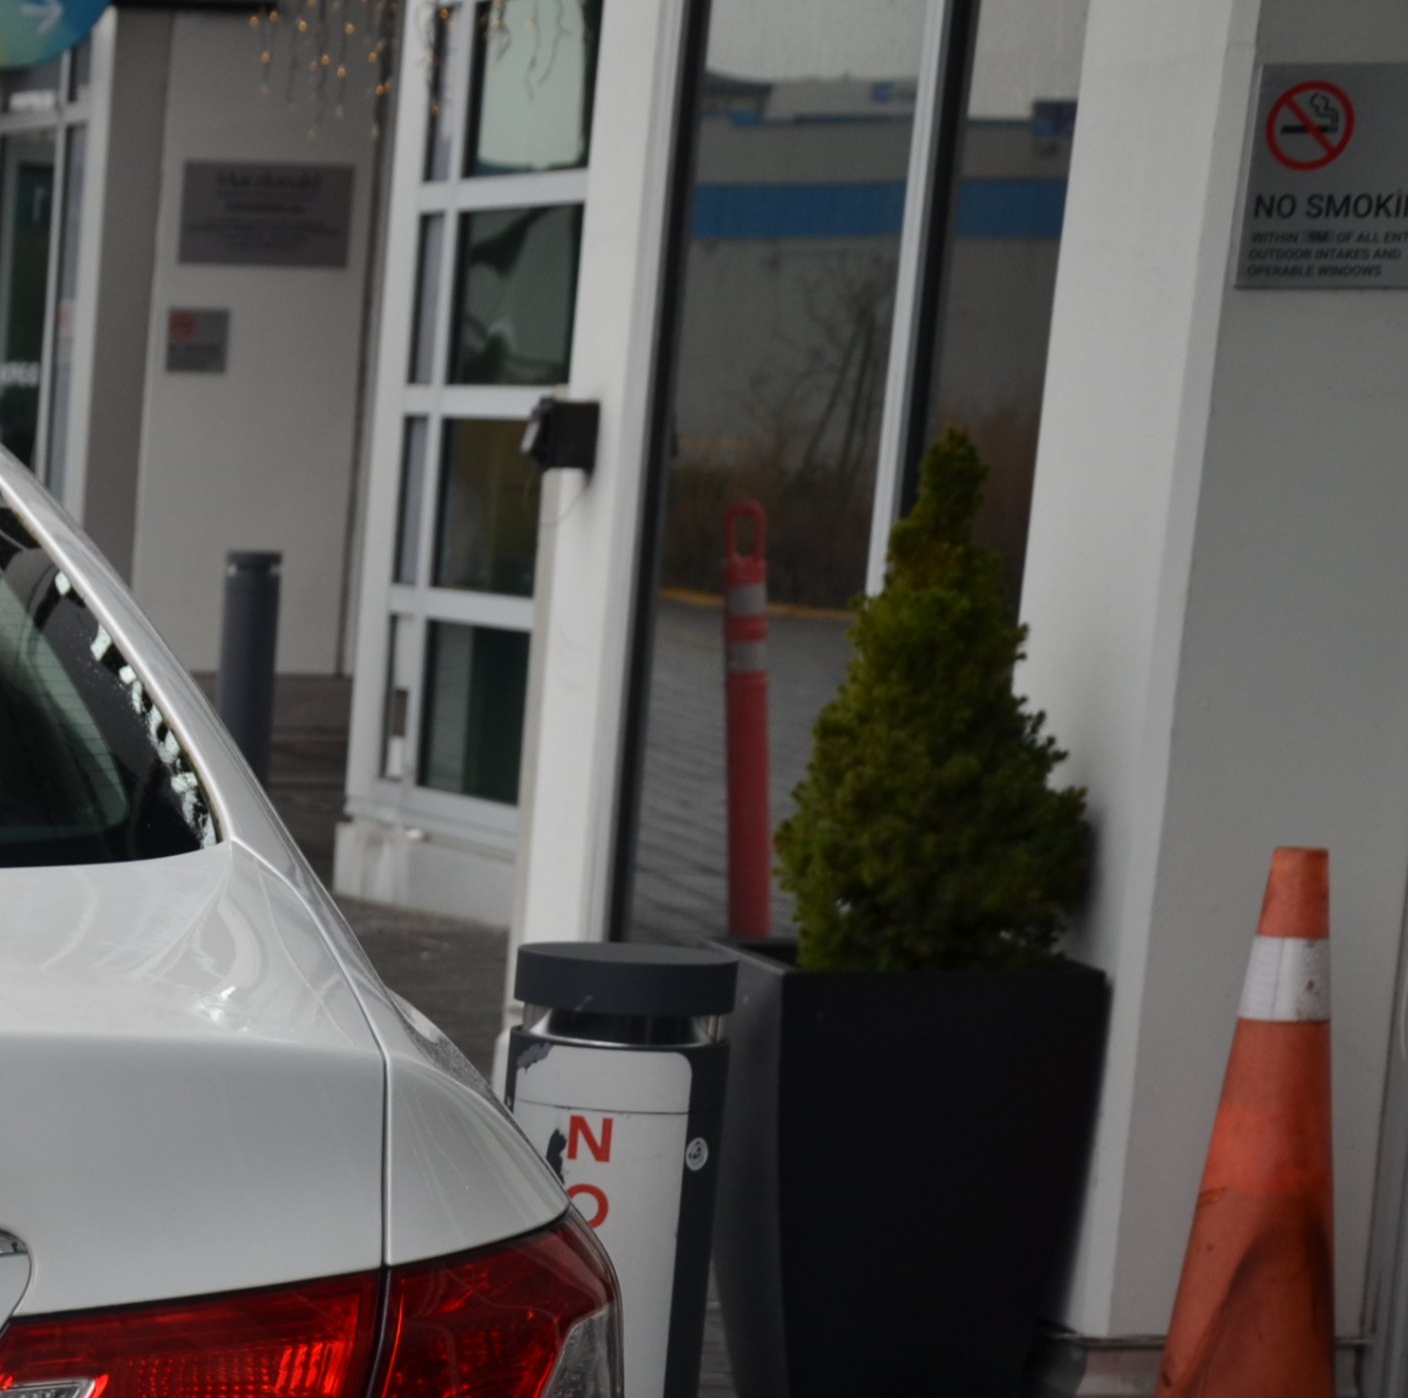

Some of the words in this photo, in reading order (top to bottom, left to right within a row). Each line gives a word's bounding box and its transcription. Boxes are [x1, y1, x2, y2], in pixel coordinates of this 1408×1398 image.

[1254, 193, 1297, 218] NO
[1305, 190, 1408, 218] SMOKI
[1252, 231, 1299, 243] WITHIN
[1336, 231, 1353, 243] OF
[1356, 231, 1379, 243] ALL
[1249, 248, 1312, 260] OUTDOOR
[1314, 248, 1369, 260] INTAKES
[1372, 248, 1402, 260] AND
[1248, 264, 1313, 277] OPERABLE
[1317, 264, 1382, 277] WINDOWS
